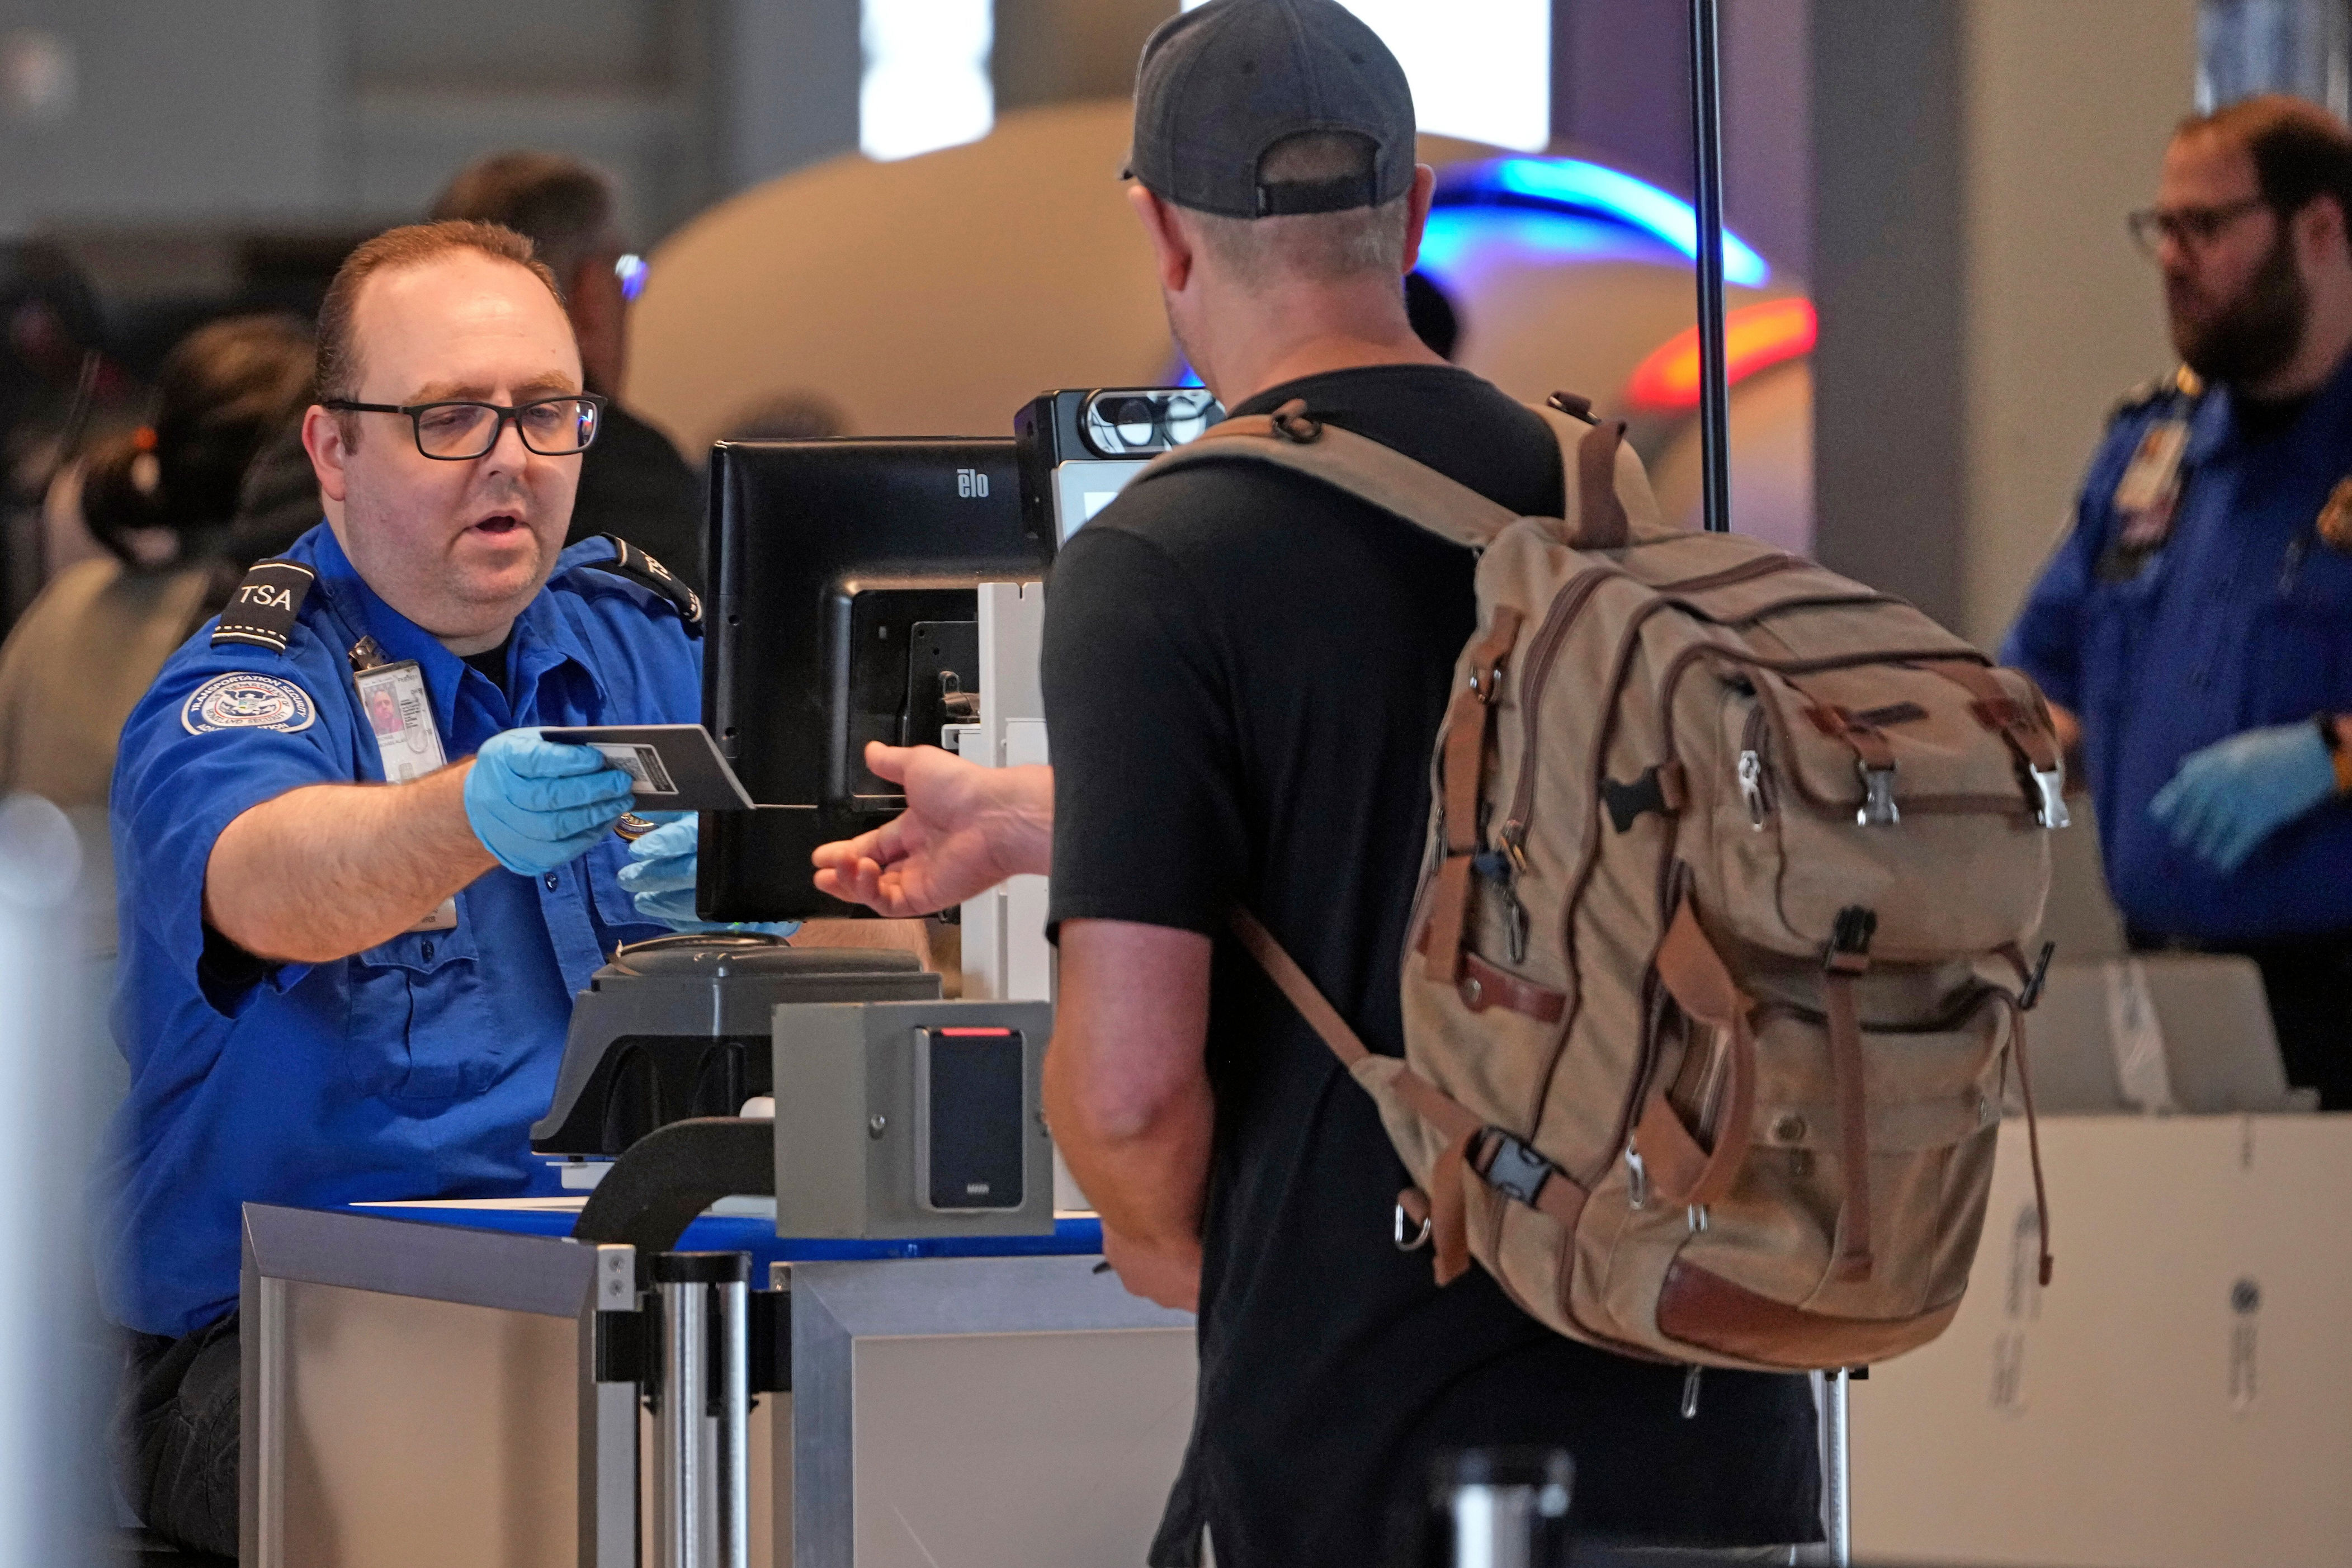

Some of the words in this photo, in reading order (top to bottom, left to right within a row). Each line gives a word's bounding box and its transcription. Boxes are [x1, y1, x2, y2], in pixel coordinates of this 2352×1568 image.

[240, 585, 290, 611] TSA
[191, 675, 282, 712] TRANSPORTATION
[280, 685, 306, 717] SECURITY
